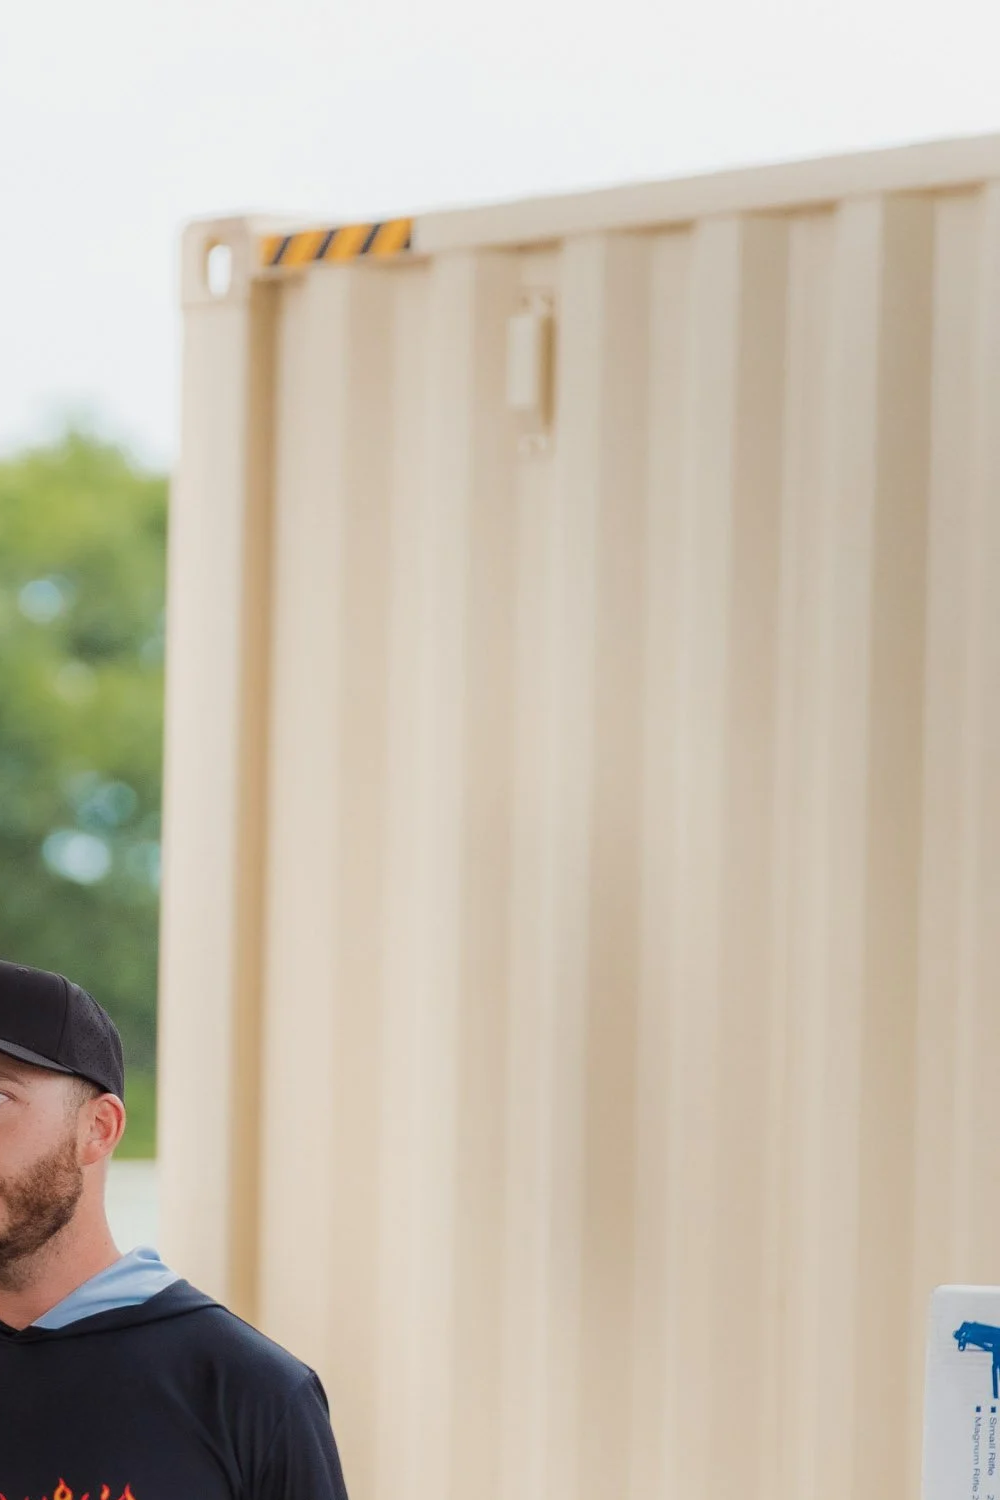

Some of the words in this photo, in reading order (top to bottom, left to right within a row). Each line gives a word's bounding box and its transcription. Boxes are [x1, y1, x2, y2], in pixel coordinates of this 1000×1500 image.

[972, 1416, 982, 1465] Magnum
[989, 1417, 998, 1449] Small
[988, 1452, 997, 1476] Rifle
[972, 1468, 981, 1492] Rifle
